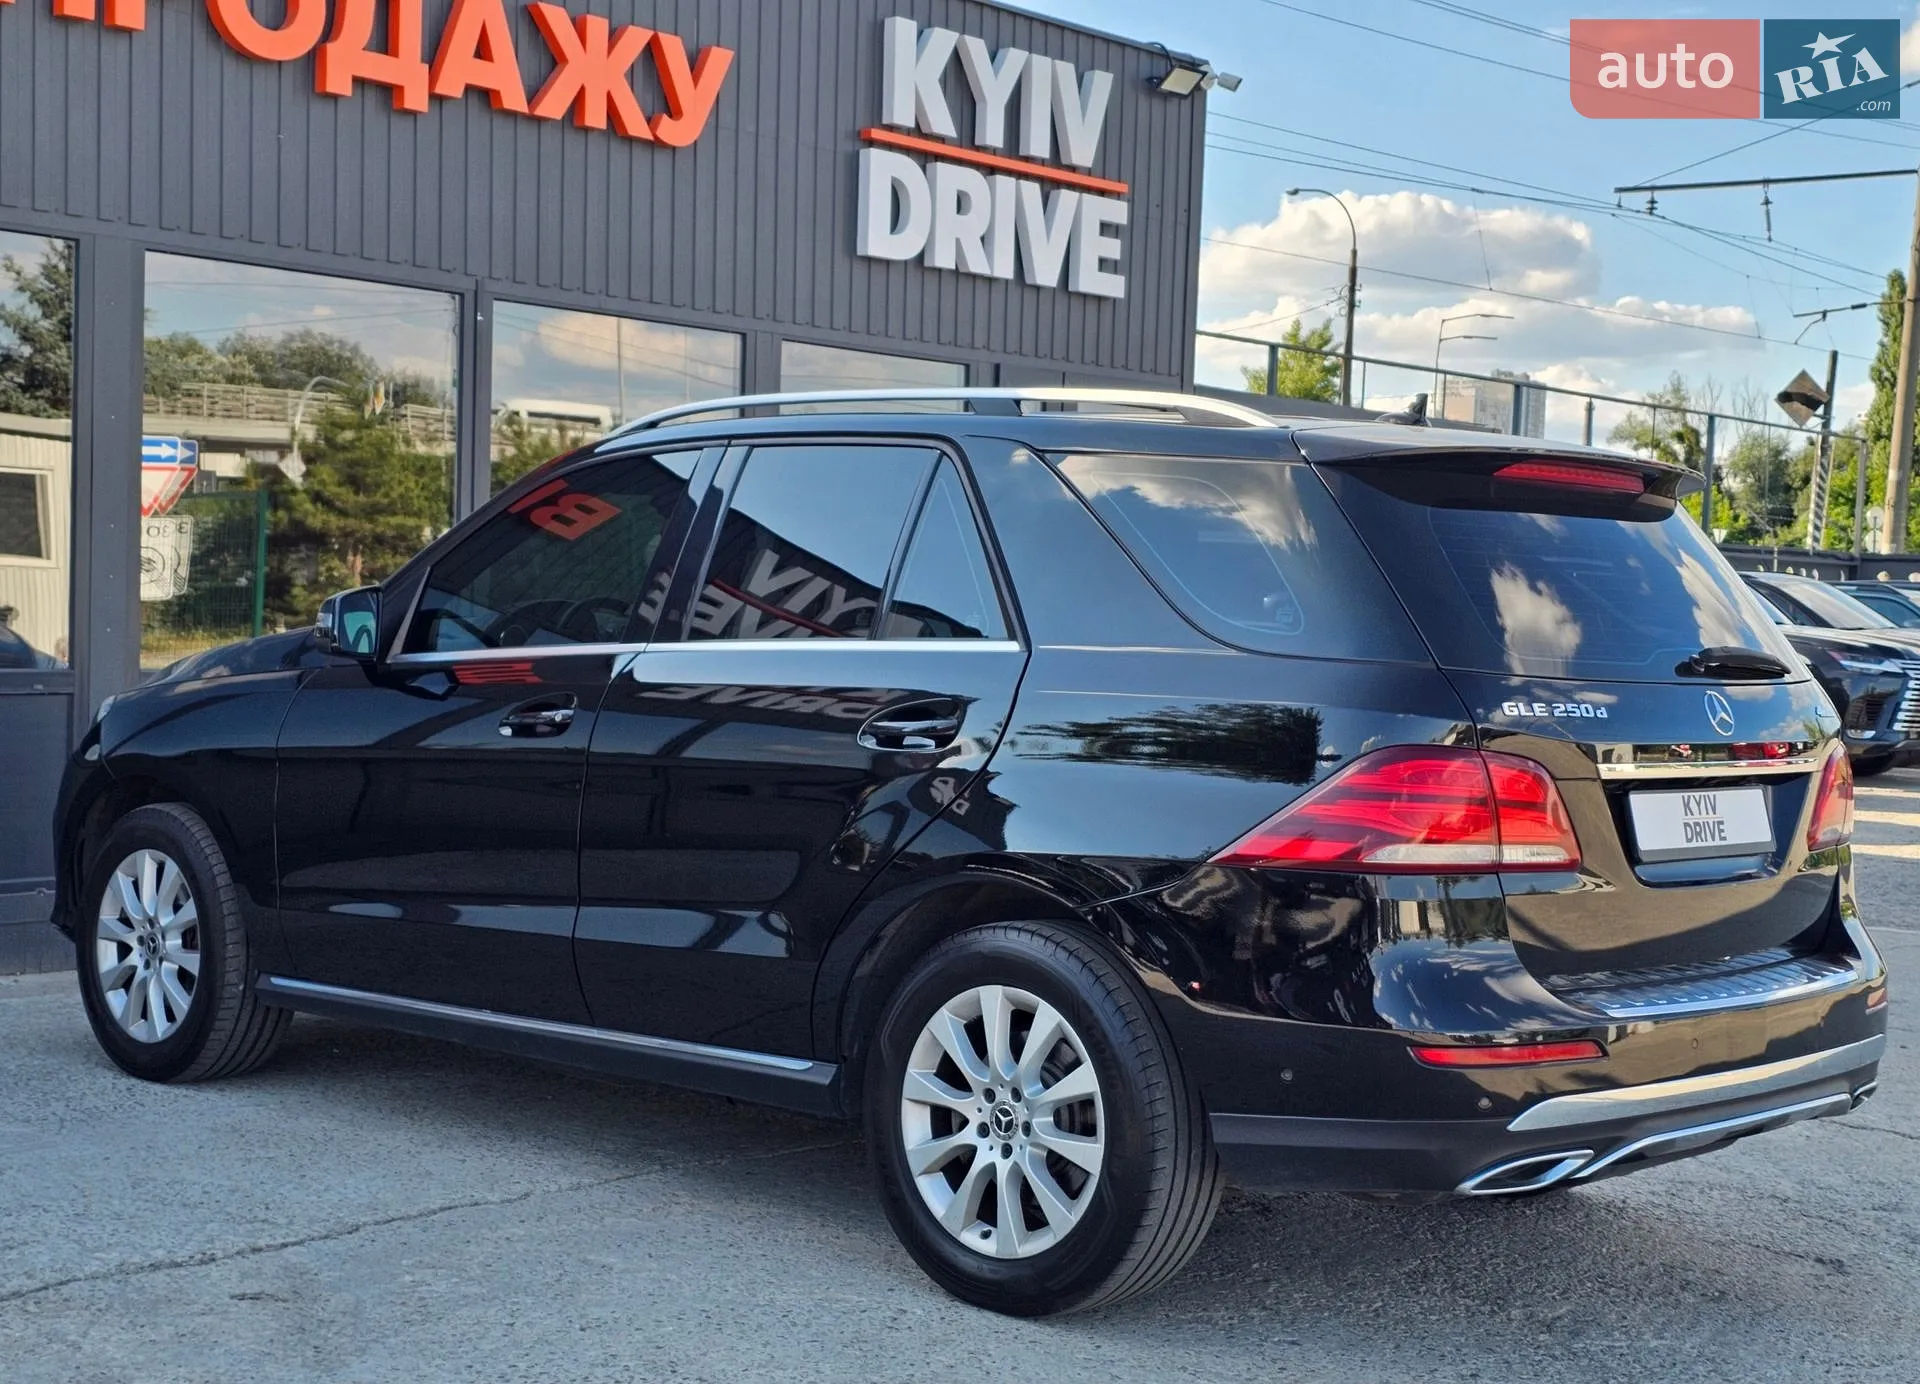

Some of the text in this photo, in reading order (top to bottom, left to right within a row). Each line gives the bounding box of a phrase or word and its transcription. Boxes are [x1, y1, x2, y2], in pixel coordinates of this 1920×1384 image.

[882, 16, 1114, 168] KYIV
[856, 147, 1128, 299] DRIVE
[1501, 702, 1549, 716] GLE
[1681, 794, 1717, 816] KYIV
[1683, 820, 1727, 843] DRIVE
